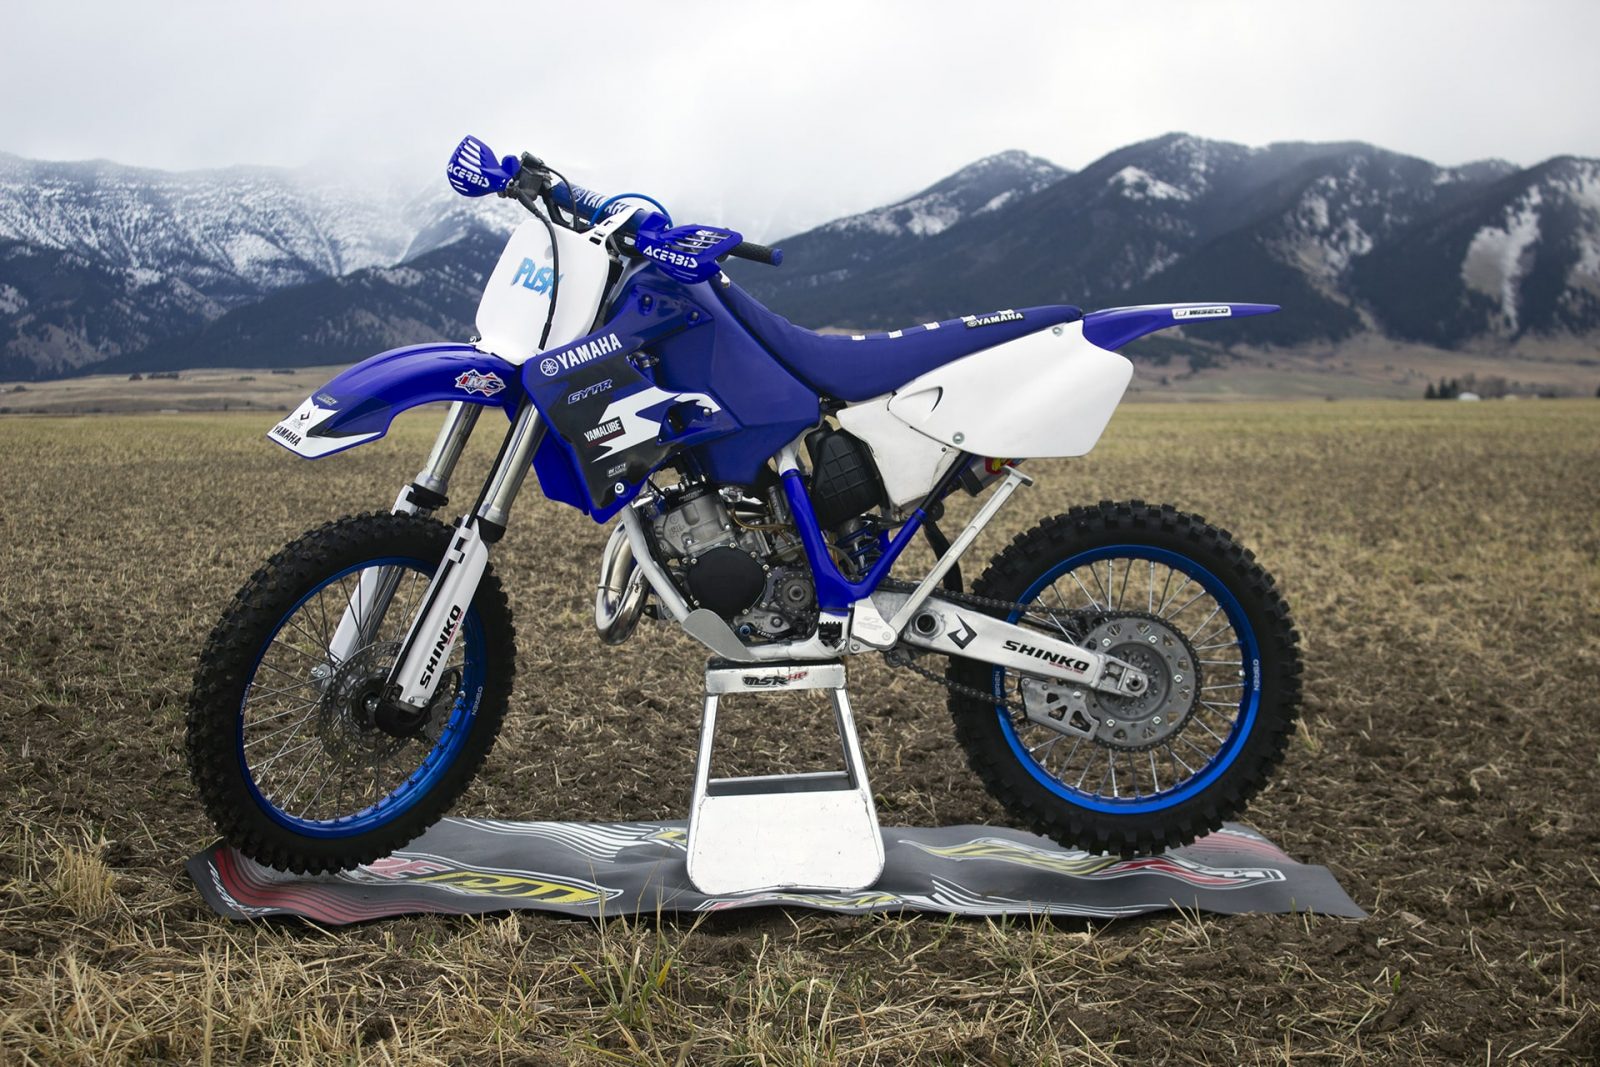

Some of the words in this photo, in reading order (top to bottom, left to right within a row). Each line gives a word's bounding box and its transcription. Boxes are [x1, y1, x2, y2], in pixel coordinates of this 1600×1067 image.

[976, 312, 1023, 326] YAMAHA
[556, 333, 622, 370] YAMAHA
[567, 378, 613, 405] GYTR
[272, 425, 302, 447] YAMAHA
[583, 418, 622, 442] YAMALUBE
[419, 604, 462, 690] SHINKO
[1002, 640, 1090, 672] SHINKO
